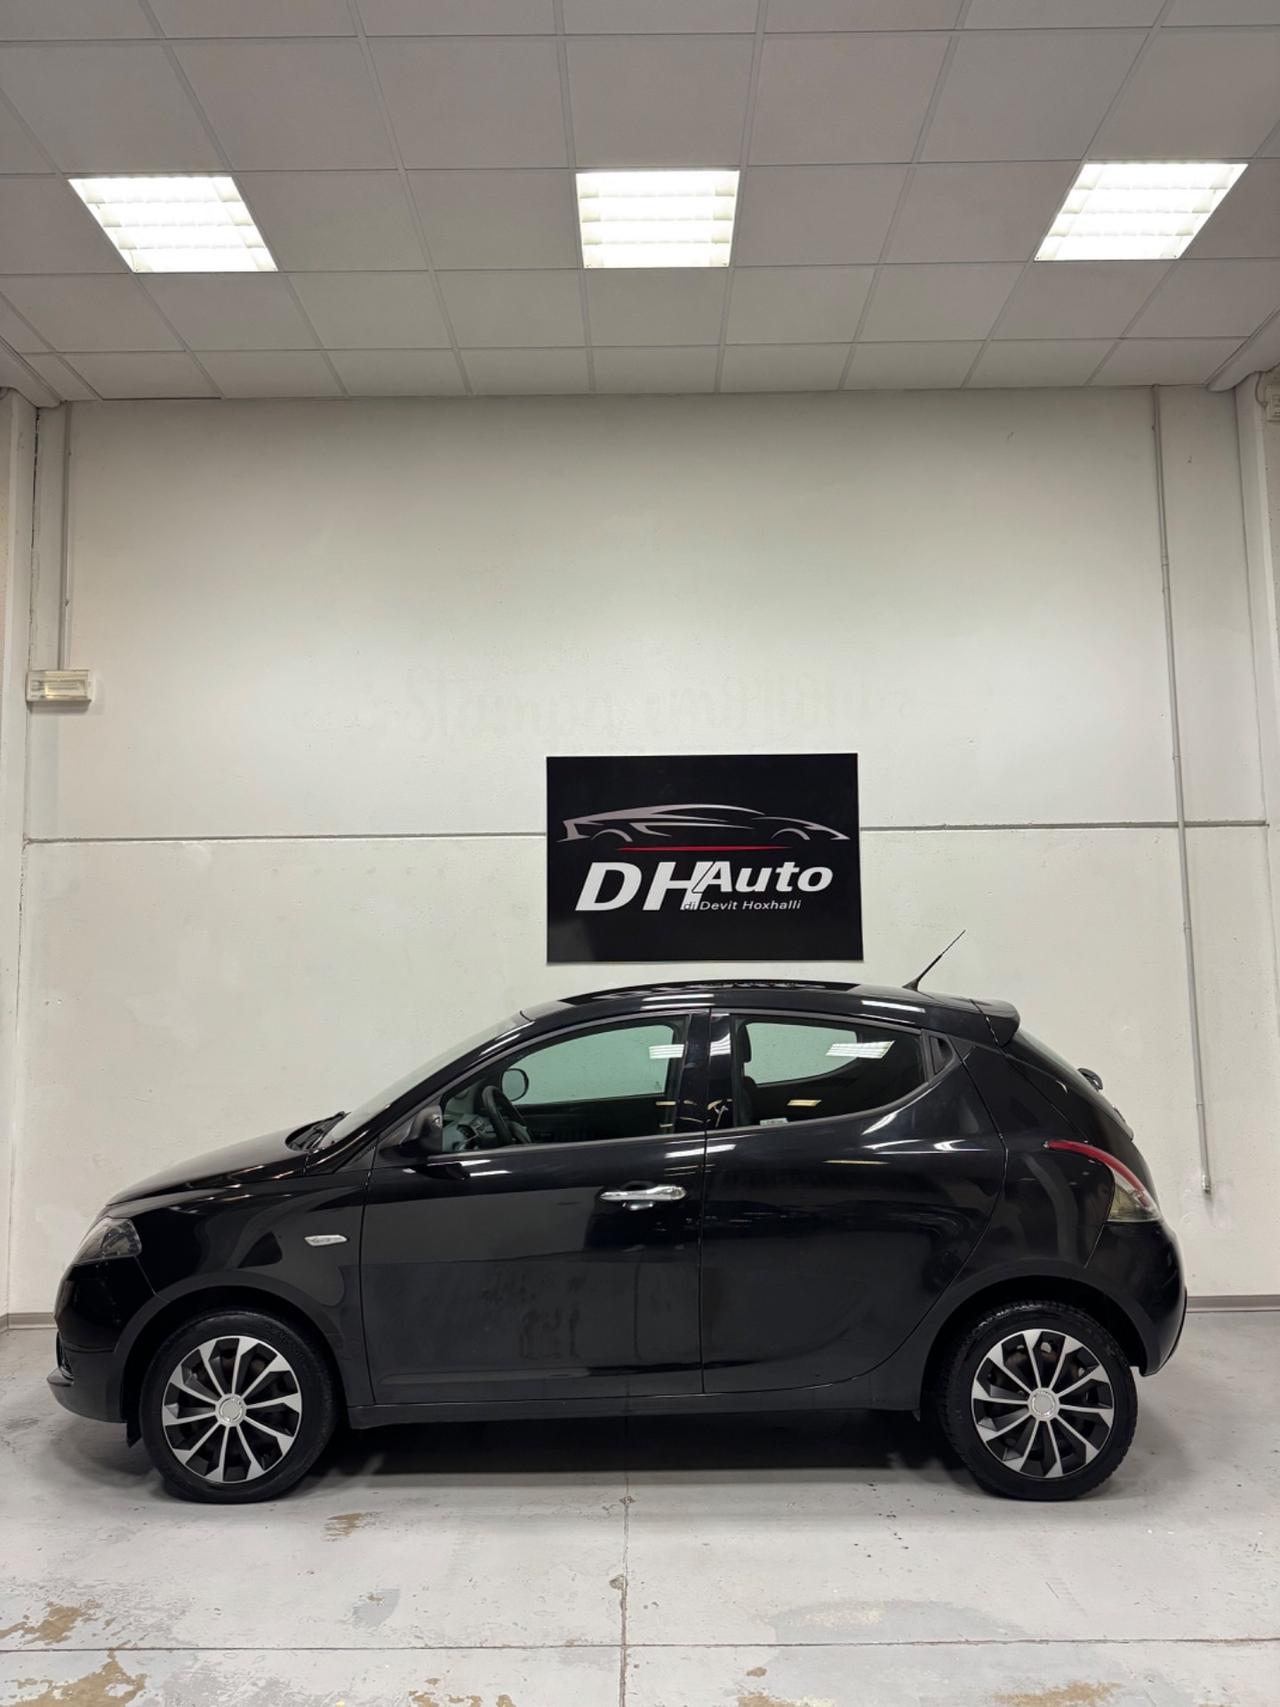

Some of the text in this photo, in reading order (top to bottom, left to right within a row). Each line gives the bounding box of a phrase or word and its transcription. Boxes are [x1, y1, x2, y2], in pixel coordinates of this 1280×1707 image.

[683, 899, 802, 911] di Devit Hoxhalli
